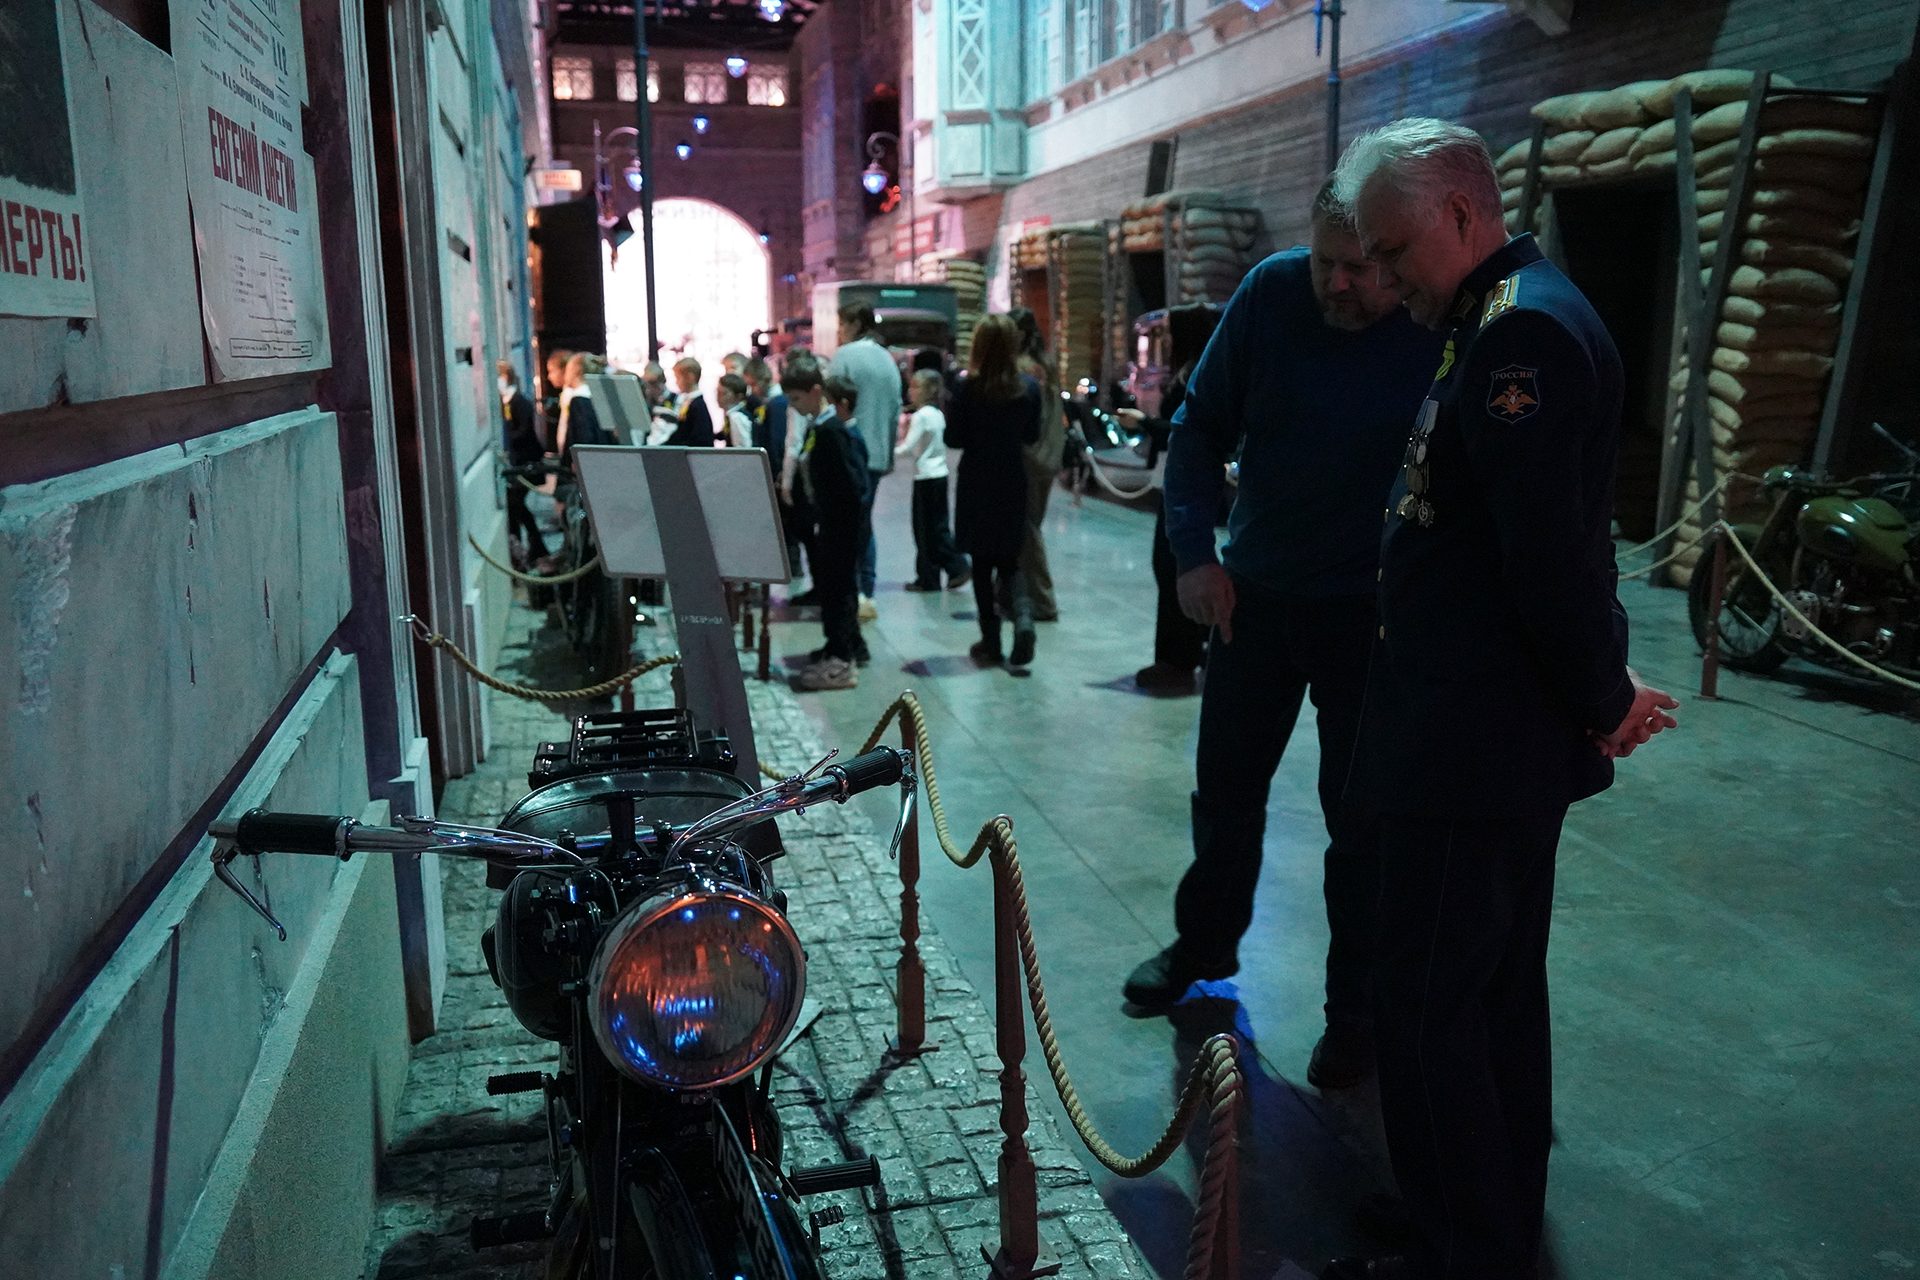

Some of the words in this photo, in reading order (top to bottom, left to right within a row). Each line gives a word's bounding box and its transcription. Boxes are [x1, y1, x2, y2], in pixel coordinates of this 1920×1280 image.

[208, 106, 262, 197] ЕВГЕНИЙ
[262, 141, 297, 214] ОНЕГИН
[1495, 371, 1534, 380] РОССИЯ
